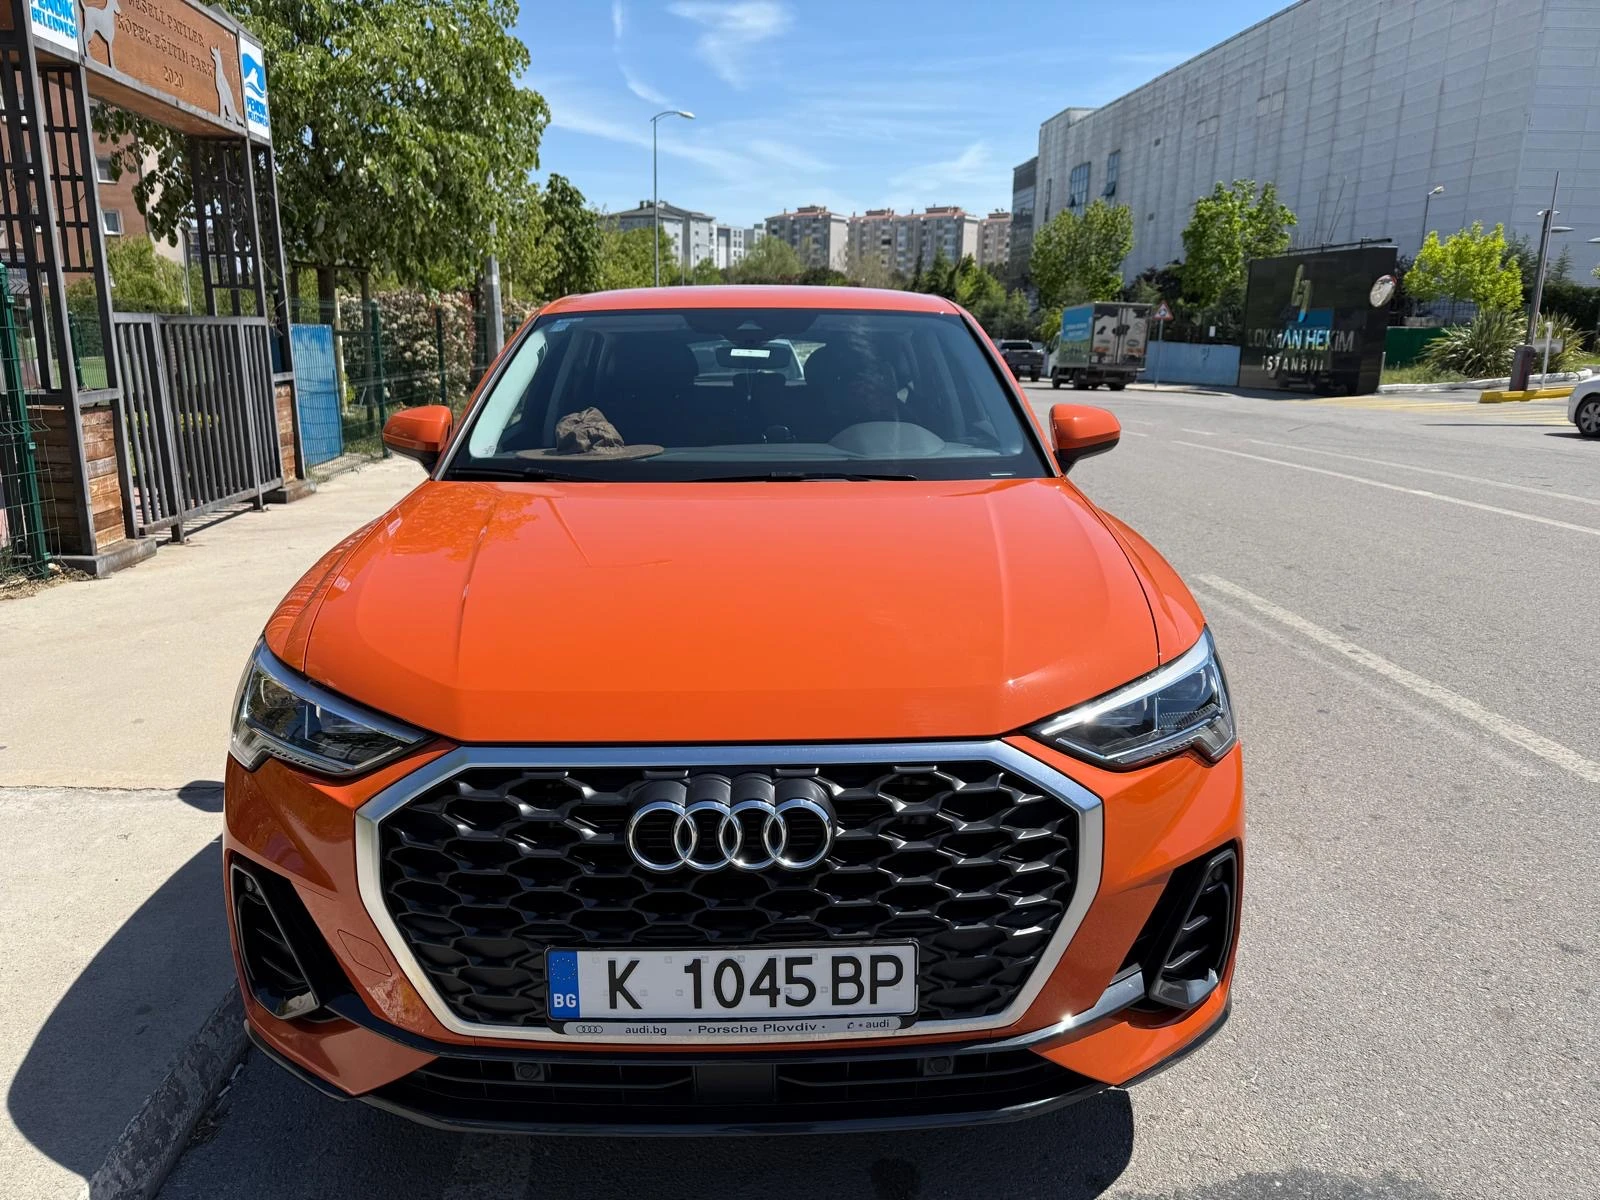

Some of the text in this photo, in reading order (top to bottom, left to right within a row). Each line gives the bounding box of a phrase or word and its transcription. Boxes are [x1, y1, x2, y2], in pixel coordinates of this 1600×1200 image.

[163, 65, 184, 89] 2020
[1247, 328, 1302, 350] LOKMAN
[607, 954, 904, 1010] K 1045 BP
[553, 993, 577, 1008] BG
[625, 1019, 889, 1036] audi.bg Porsche Plovdiv audi
